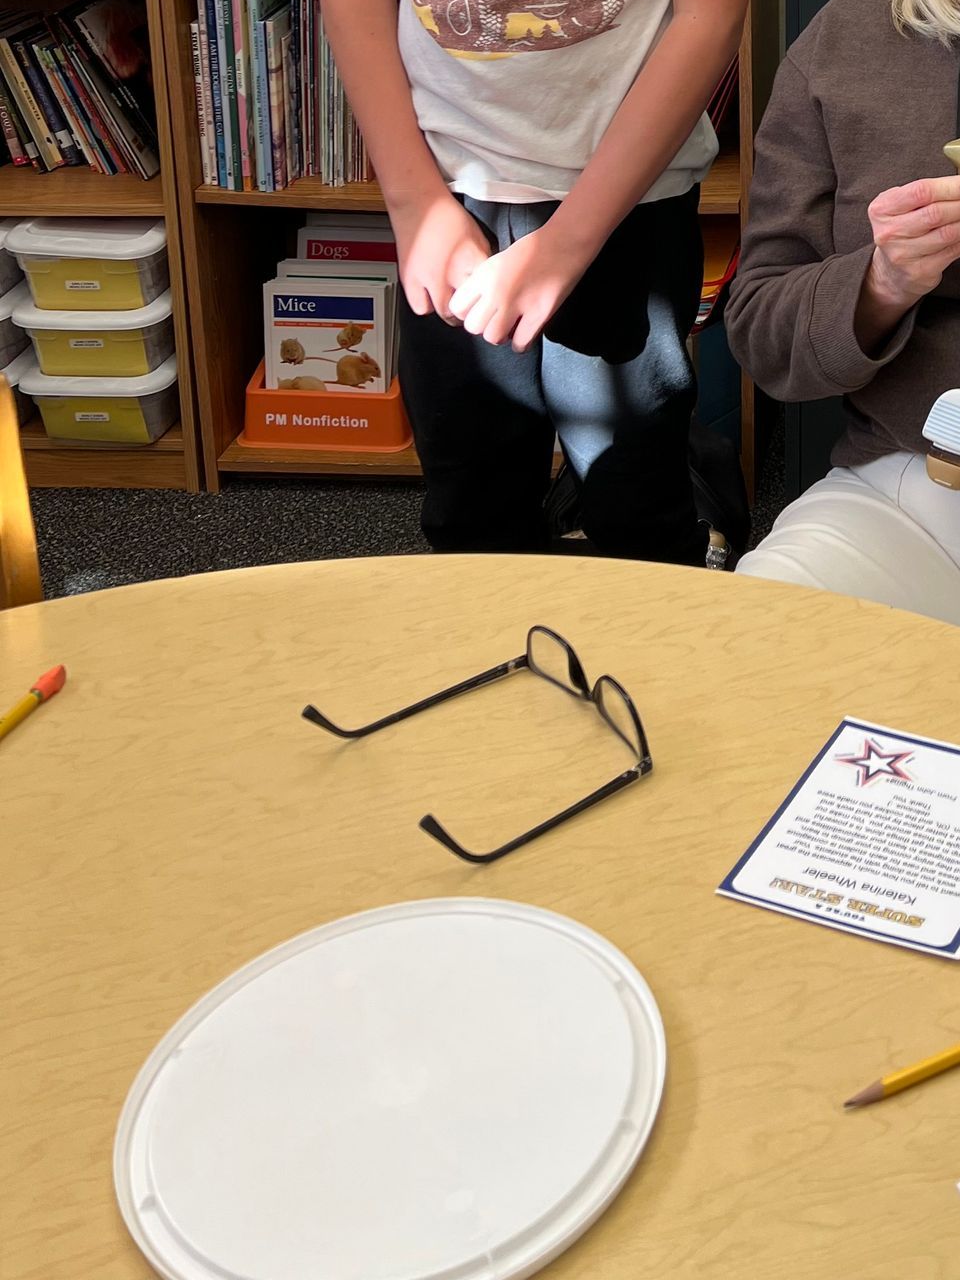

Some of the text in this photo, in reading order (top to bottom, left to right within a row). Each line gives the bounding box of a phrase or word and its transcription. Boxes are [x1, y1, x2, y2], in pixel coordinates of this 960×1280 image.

[191, 31, 206, 137] STEVE YOUNG FOREVER YOUNG
[310, 241, 350, 260] Dogs
[277, 297, 316, 313] Mice
[265, 413, 369, 428] PM Nonfiction
[800, 866, 918, 906] Katerina Wheeler
[767, 876, 927, 928] SUPER STAR!
